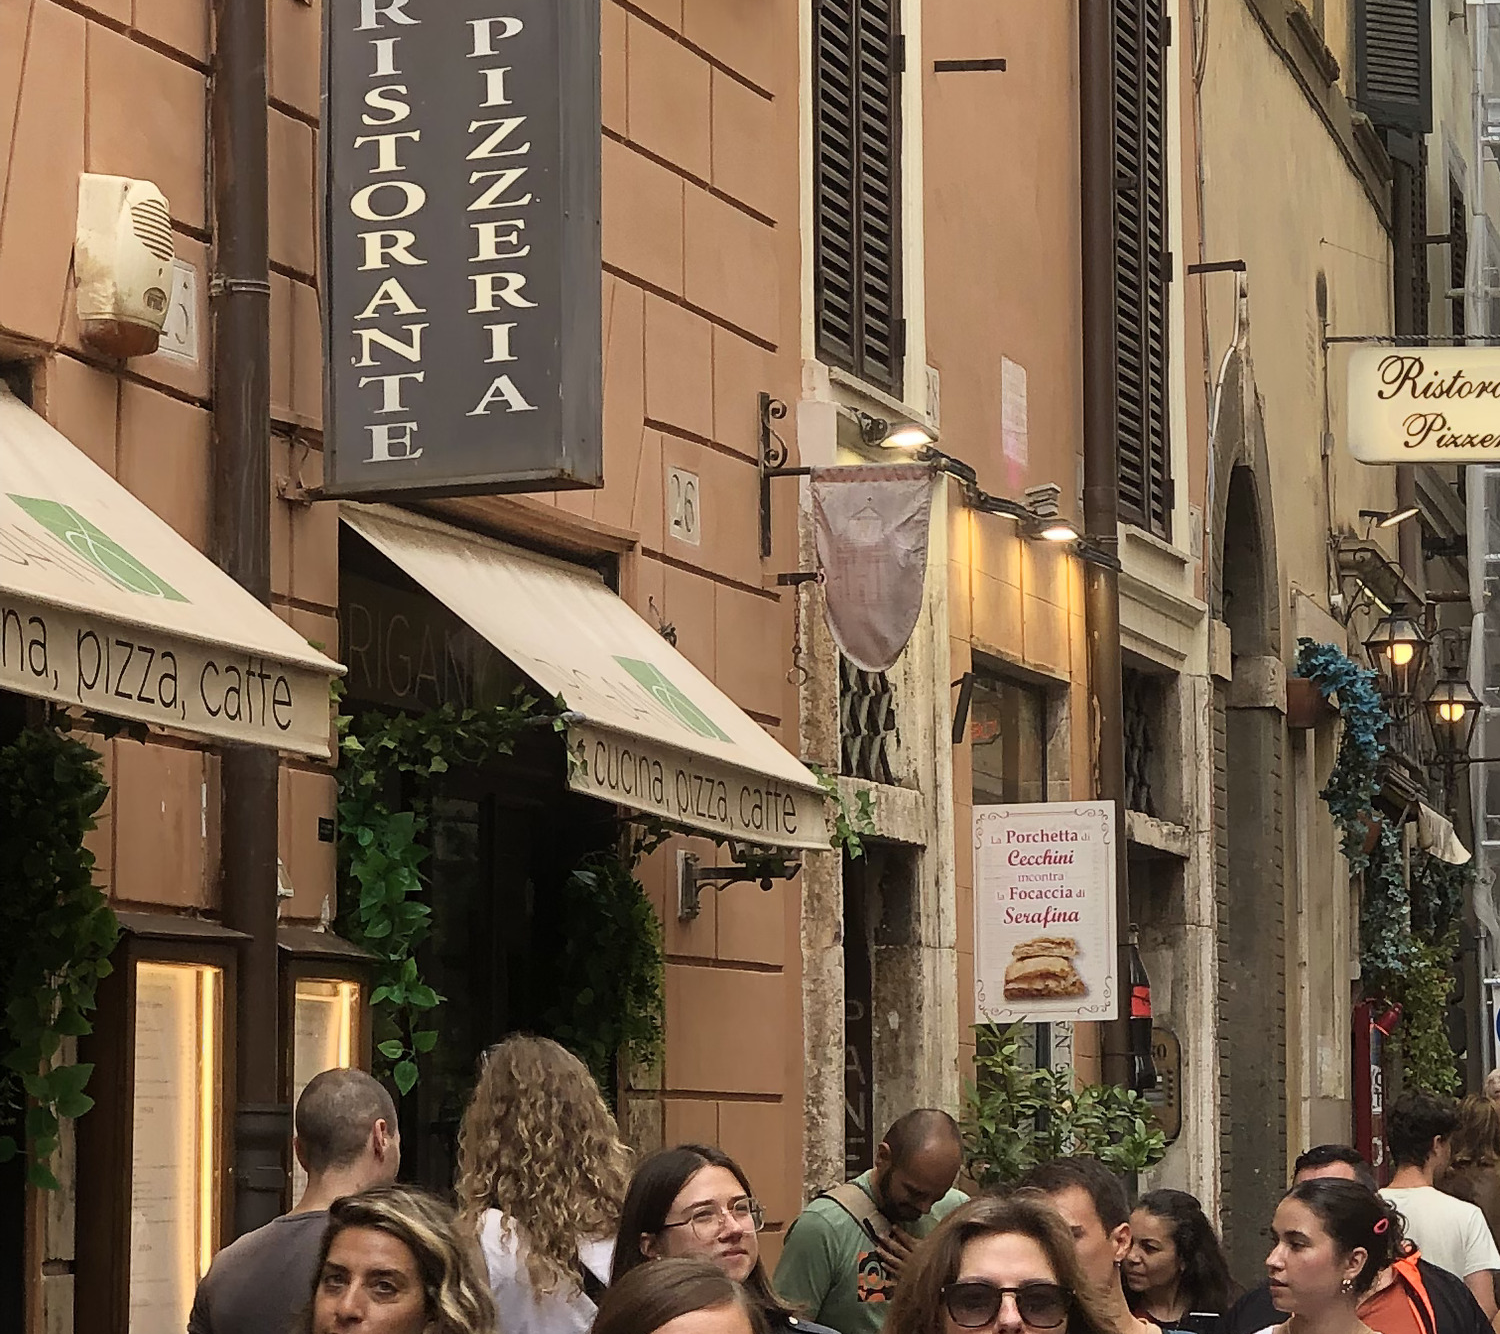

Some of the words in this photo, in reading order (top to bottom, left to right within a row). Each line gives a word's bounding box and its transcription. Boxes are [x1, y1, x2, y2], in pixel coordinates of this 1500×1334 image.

[465, 15, 539, 417] PIZZERIA
[76, 628, 187, 721] pizza,
[594, 739, 671, 810] cucina,
[676, 761, 734, 826] pizza,
[1006, 829, 1078, 844] Porchetta
[1081, 832, 1091, 841] di
[1007, 848, 1075, 867] Cecchini
[1009, 885, 1073, 901] Focaccia
[1076, 888, 1086, 899] di
[1003, 905, 1081, 929] Serafina
